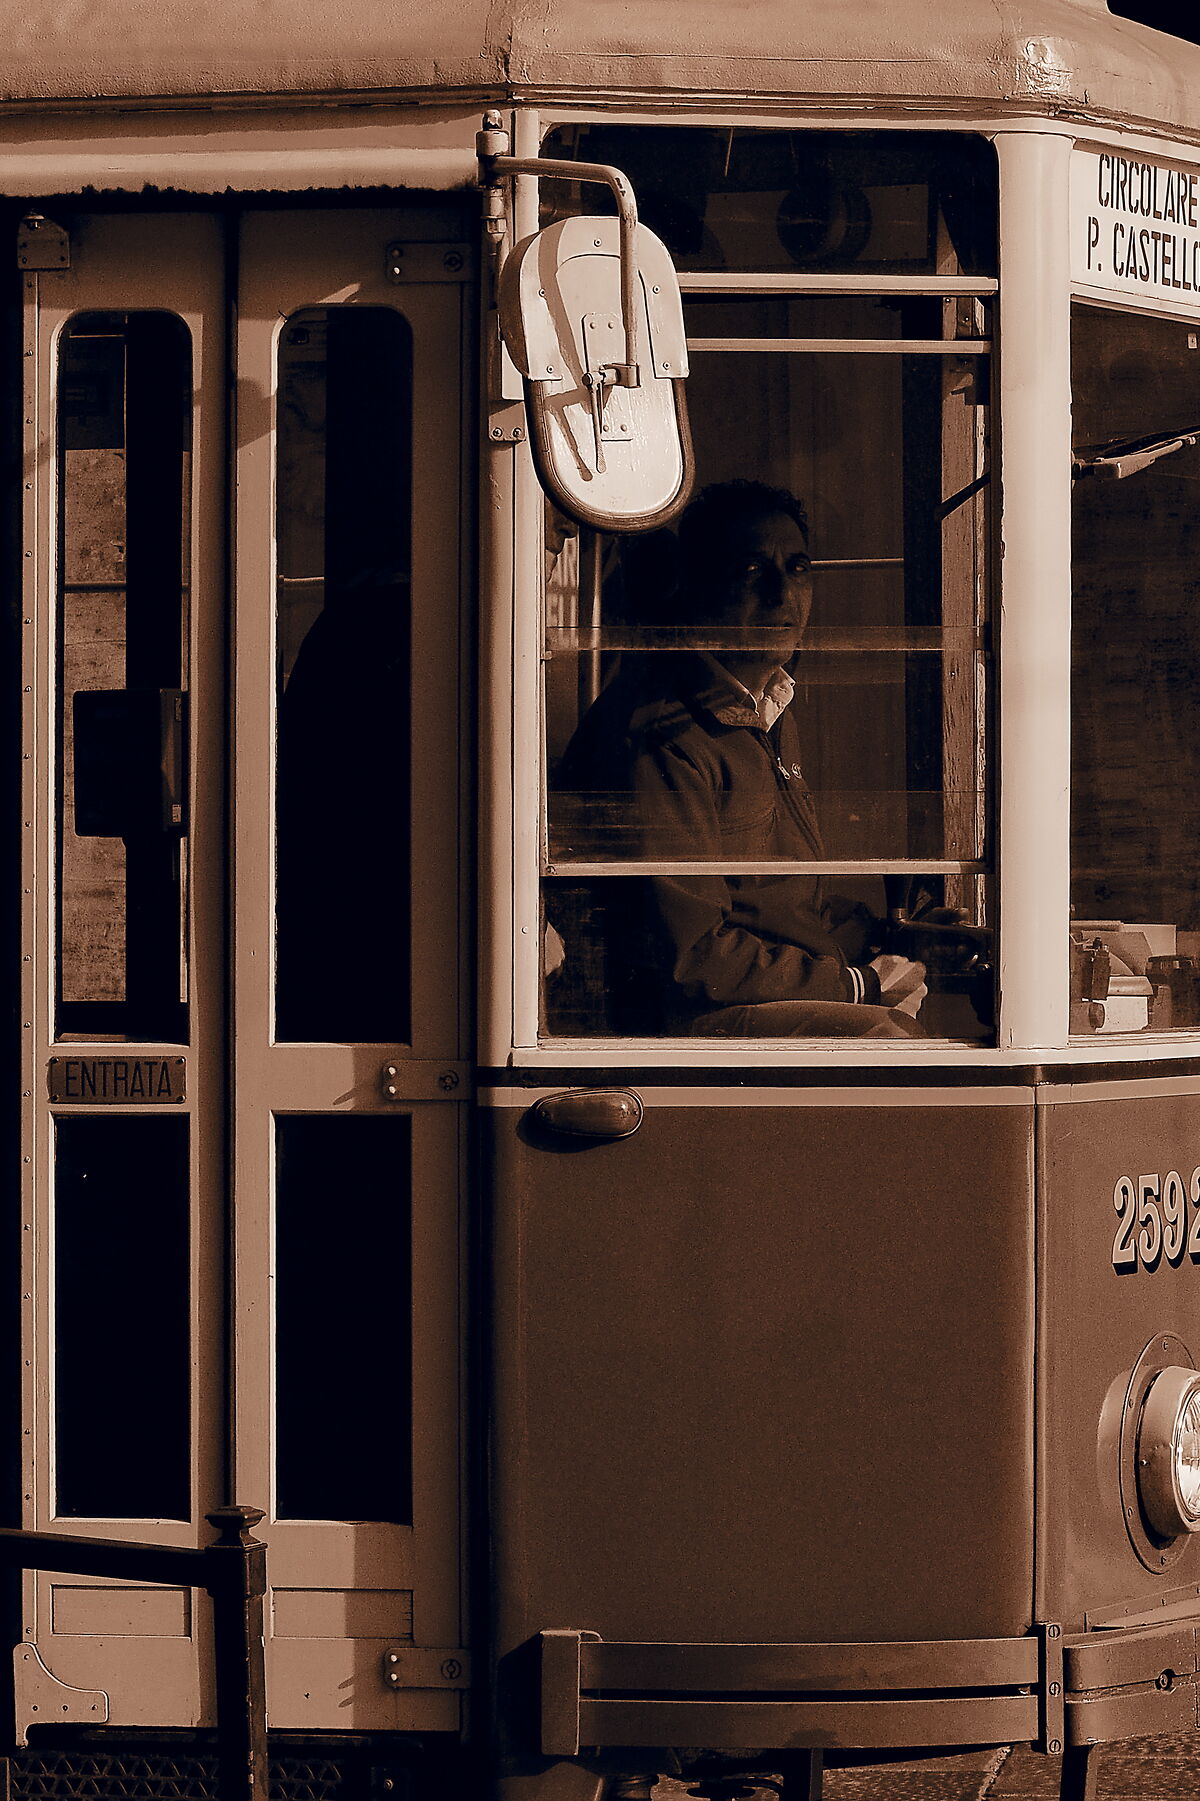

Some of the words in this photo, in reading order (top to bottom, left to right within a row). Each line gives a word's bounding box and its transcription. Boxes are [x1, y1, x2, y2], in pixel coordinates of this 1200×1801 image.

[1098, 153, 1198, 228] CIRCOLARE
[1087, 216, 1102, 272] P.
[65, 1061, 172, 1097] ENTRATA
